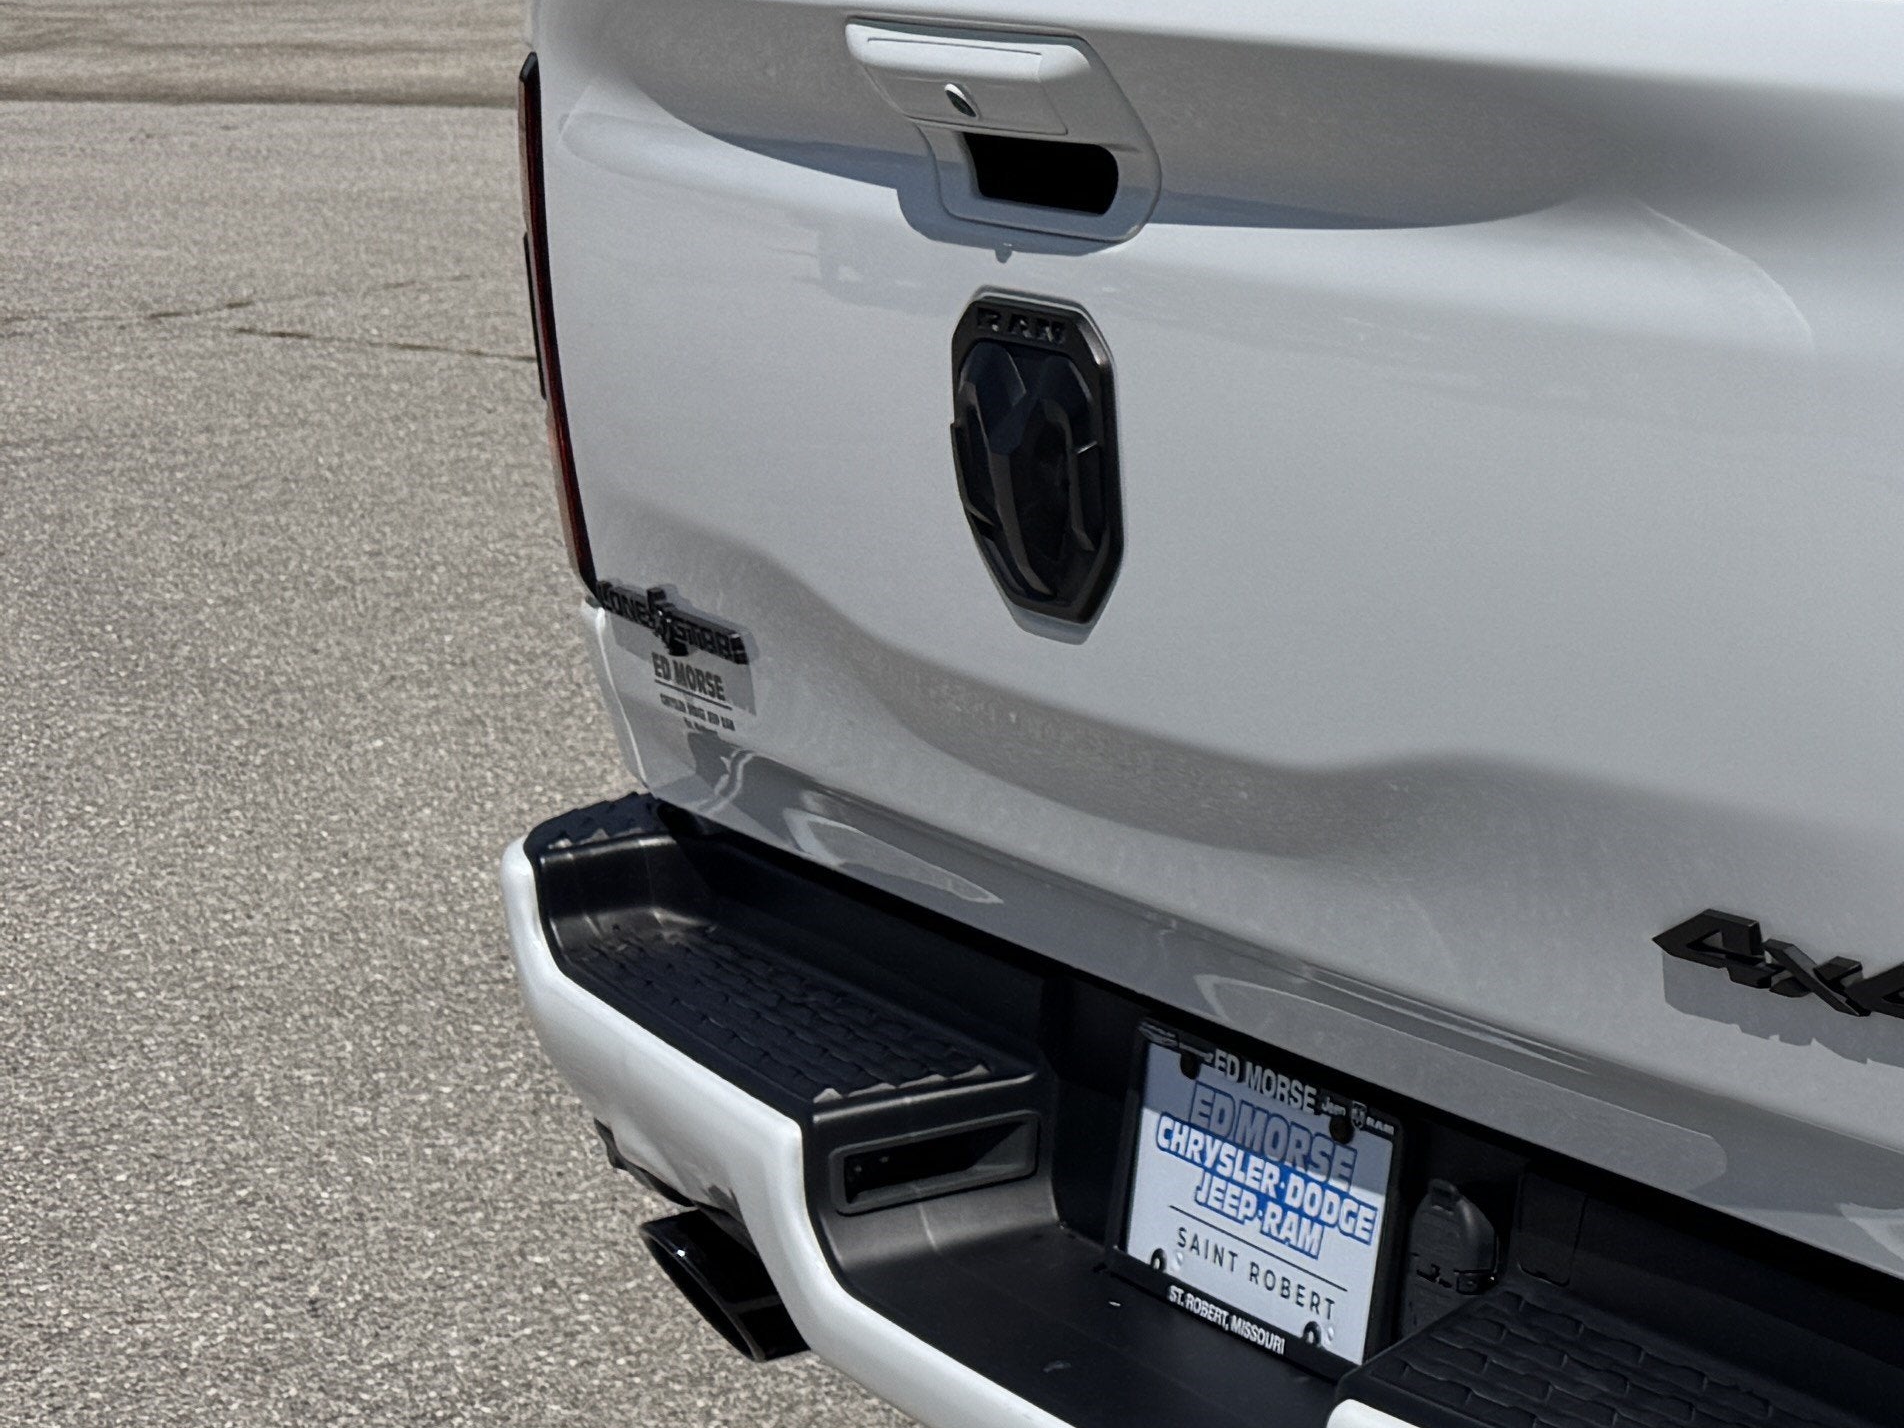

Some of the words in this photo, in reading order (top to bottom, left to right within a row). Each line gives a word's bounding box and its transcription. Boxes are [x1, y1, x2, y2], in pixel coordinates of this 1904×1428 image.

[651, 651, 672, 682] ED
[672, 659, 726, 702] MORSE
[1213, 1048, 1241, 1084] ED
[1244, 1061, 1318, 1114] MORSE
[1189, 1081, 1236, 1139] ED
[1234, 1099, 1357, 1193] MORSE
[1176, 1226, 1239, 1273] SAINT
[1249, 1260, 1336, 1321] ROBERT
[1167, 1284, 1185, 1308] ST.
[1185, 1292, 1230, 1332] ROBERT,
[1230, 1313, 1286, 1356] MISSOURI
